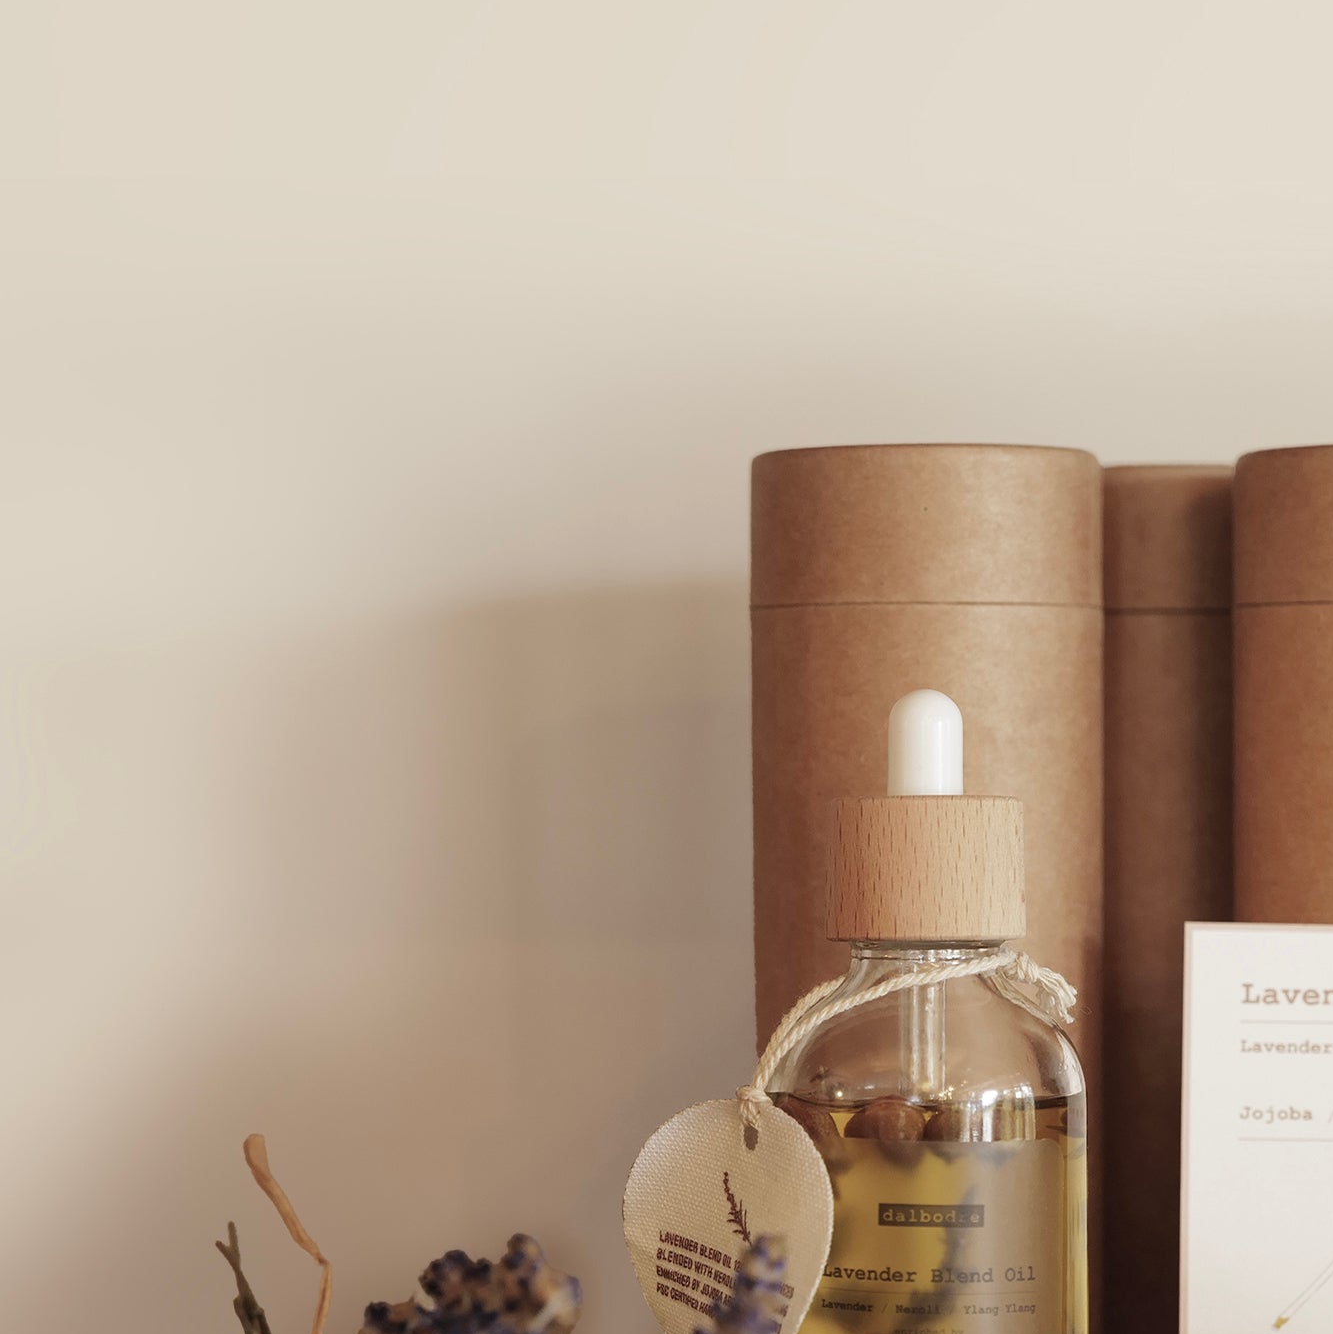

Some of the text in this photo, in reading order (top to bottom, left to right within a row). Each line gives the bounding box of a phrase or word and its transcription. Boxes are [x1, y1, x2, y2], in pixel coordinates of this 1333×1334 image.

[1240, 1106, 1313, 1123] Jojoba
[659, 1230, 698, 1253] LAVENDER
[700, 1243, 722, 1264] BLEND
[722, 1254, 732, 1268] OIL
[656, 1248, 693, 1270] BLENDED
[694, 1260, 713, 1278] WITH
[822, 1264, 1036, 1284] Lavender Blend Oil
[821, 1299, 874, 1312] Lavender
[896, 1303, 940, 1315] Neroli
[964, 1304, 1000, 1317] Ylang
[1005, 1303, 1036, 1315] Ylang
